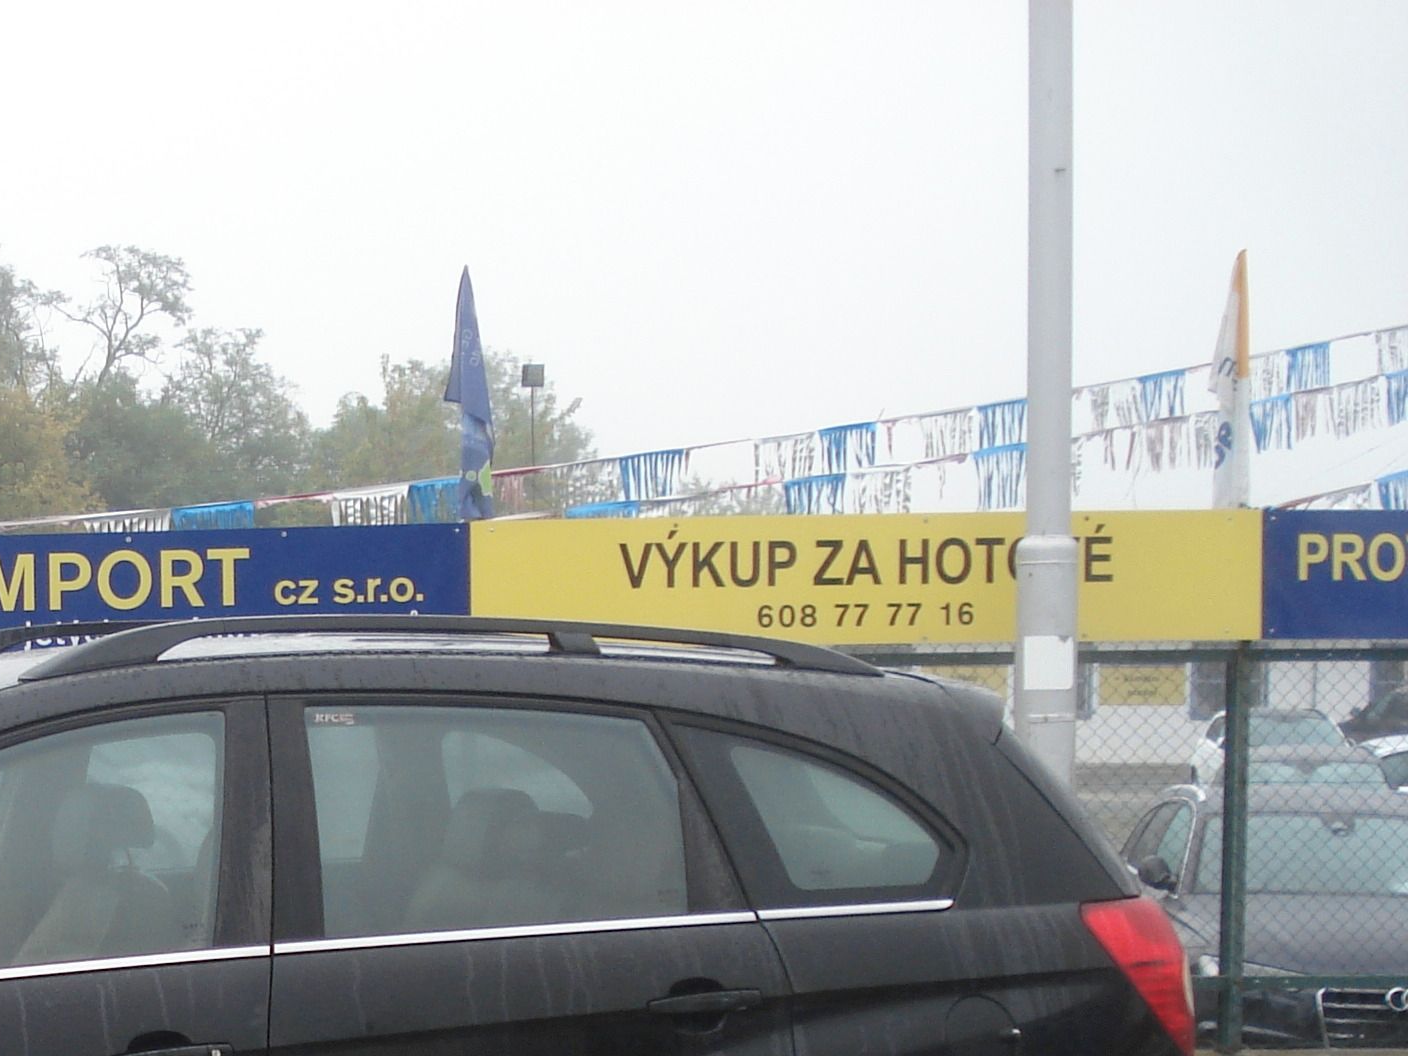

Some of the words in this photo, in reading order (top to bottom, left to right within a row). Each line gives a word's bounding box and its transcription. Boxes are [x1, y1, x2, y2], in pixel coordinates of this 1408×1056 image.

[618, 529, 797, 589] VÝKUP
[813, 539, 882, 586] ZA
[898, 524, 1114, 585] HOTÉ
[1297, 532, 1408, 582] PRO
[274, 578, 320, 606] cz
[333, 575, 424, 604] s.r.o.
[757, 604, 818, 628] 608
[834, 603, 870, 627] 77
[886, 603, 922, 626] 77
[939, 602, 974, 625] 16
